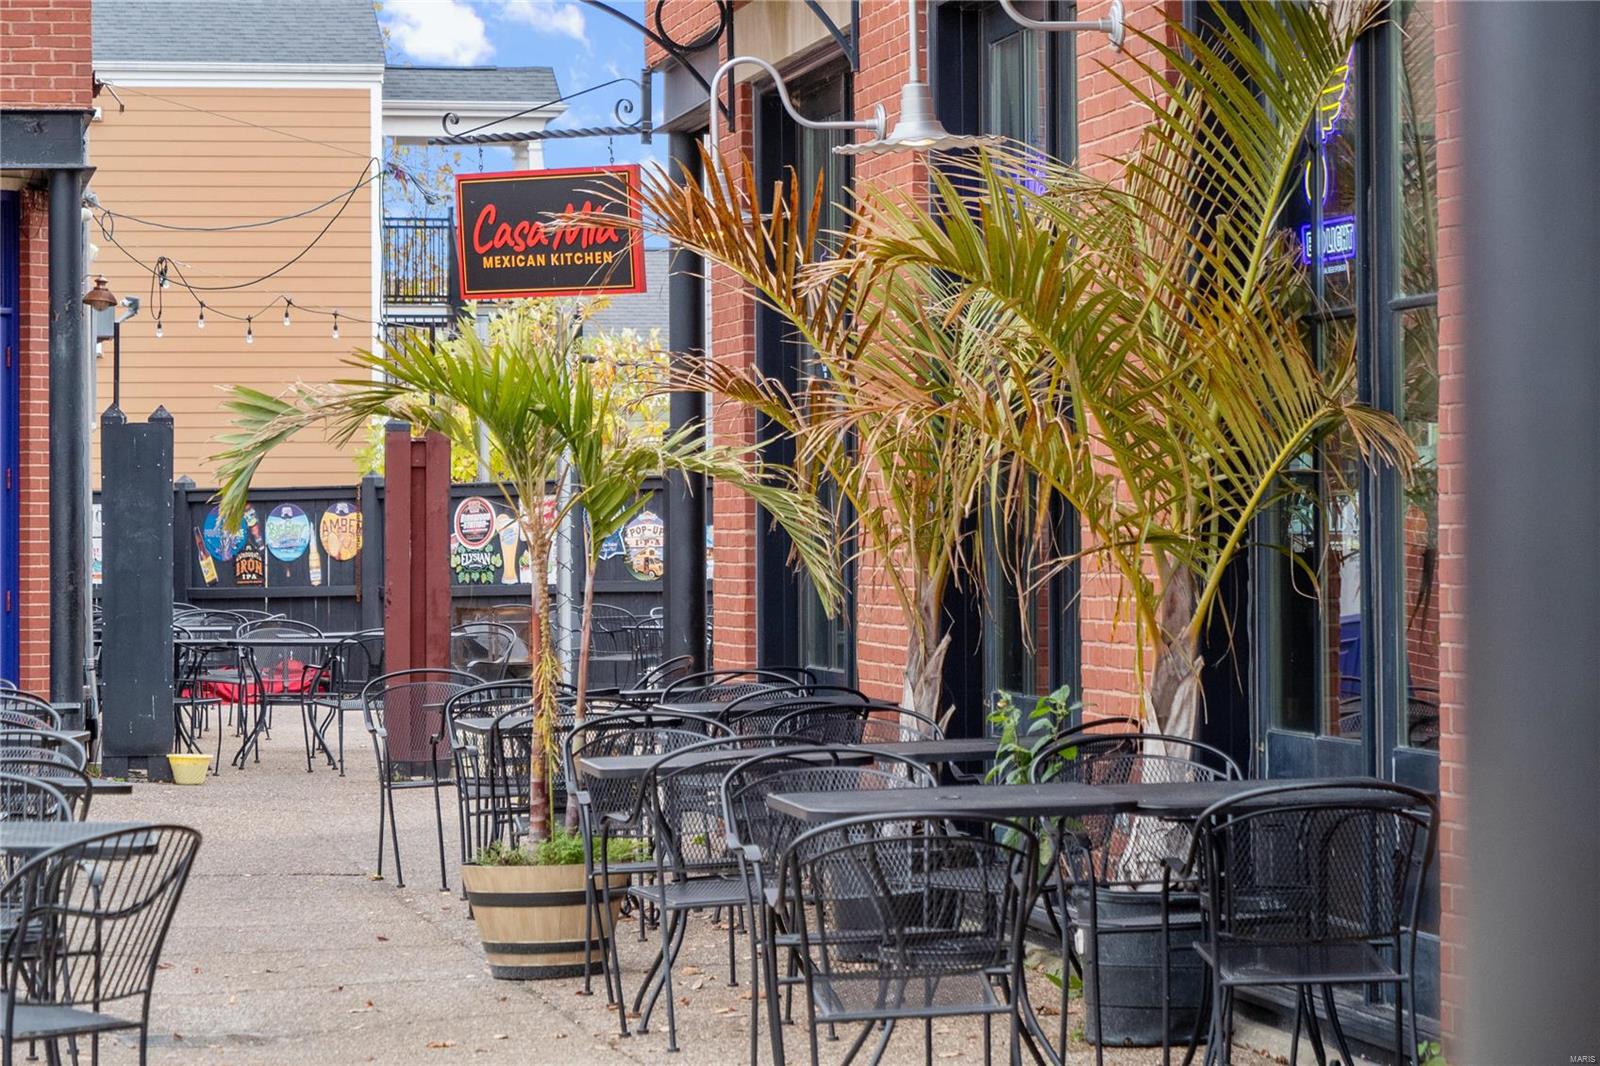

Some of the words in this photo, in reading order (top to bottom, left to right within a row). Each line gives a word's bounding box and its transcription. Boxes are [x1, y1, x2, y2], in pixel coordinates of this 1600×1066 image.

[473, 203, 549, 254] Casa
[483, 252, 546, 269] MEXICAN
[551, 251, 613, 266] KITCHEN
[236, 558, 263, 577] IRON
[461, 551, 491, 567] ELYSIAN
